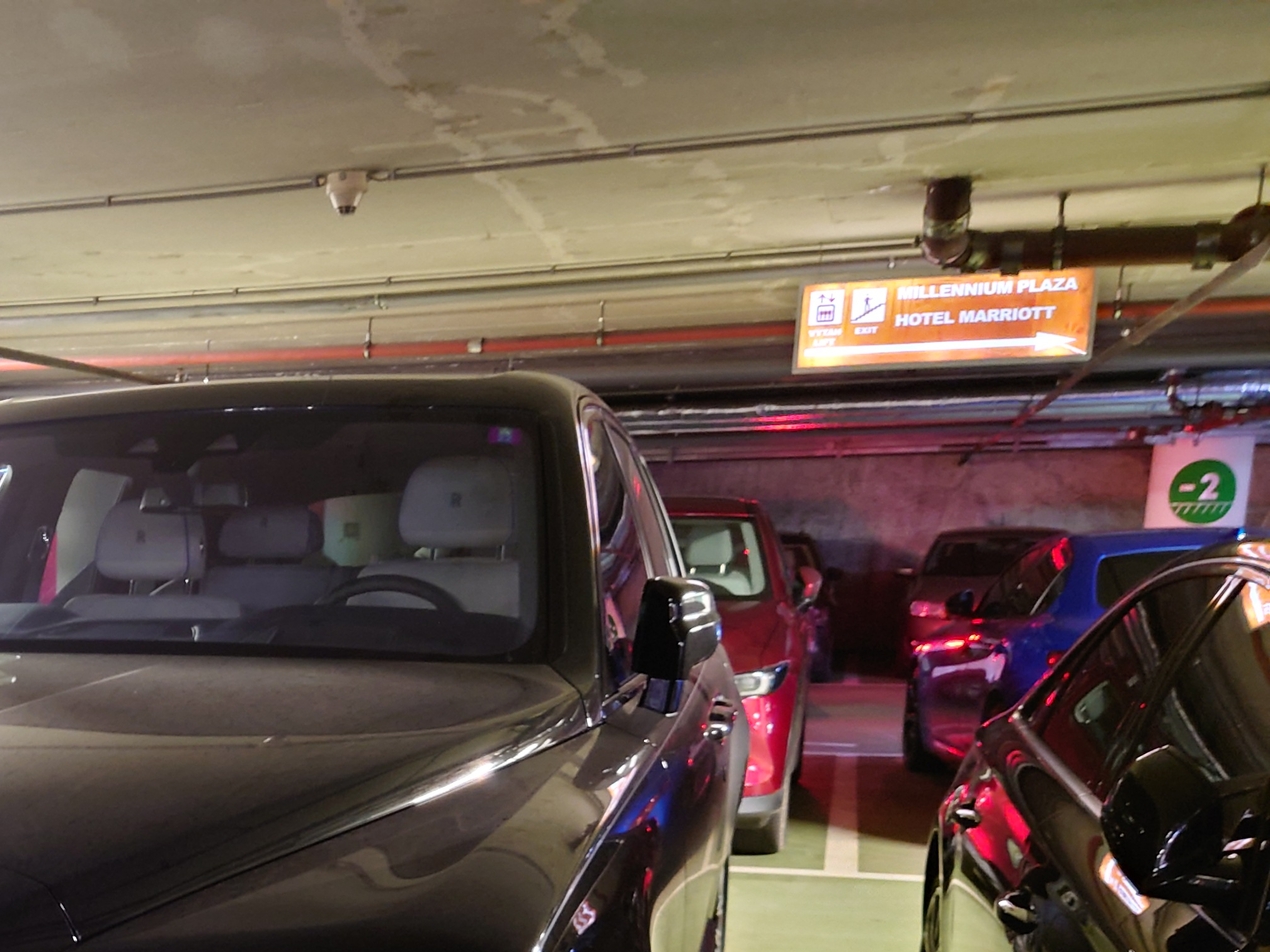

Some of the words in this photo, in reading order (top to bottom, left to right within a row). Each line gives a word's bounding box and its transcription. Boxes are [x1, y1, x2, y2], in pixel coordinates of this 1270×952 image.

[897, 280, 1013, 300] MILLENNIUM
[1017, 277, 1078, 294] PLAZA
[894, 310, 955, 327] HOTEL
[959, 305, 1057, 323] MARRIOTT
[854, 326, 879, 335] EXIT
[1179, 472, 1220, 501] -2
